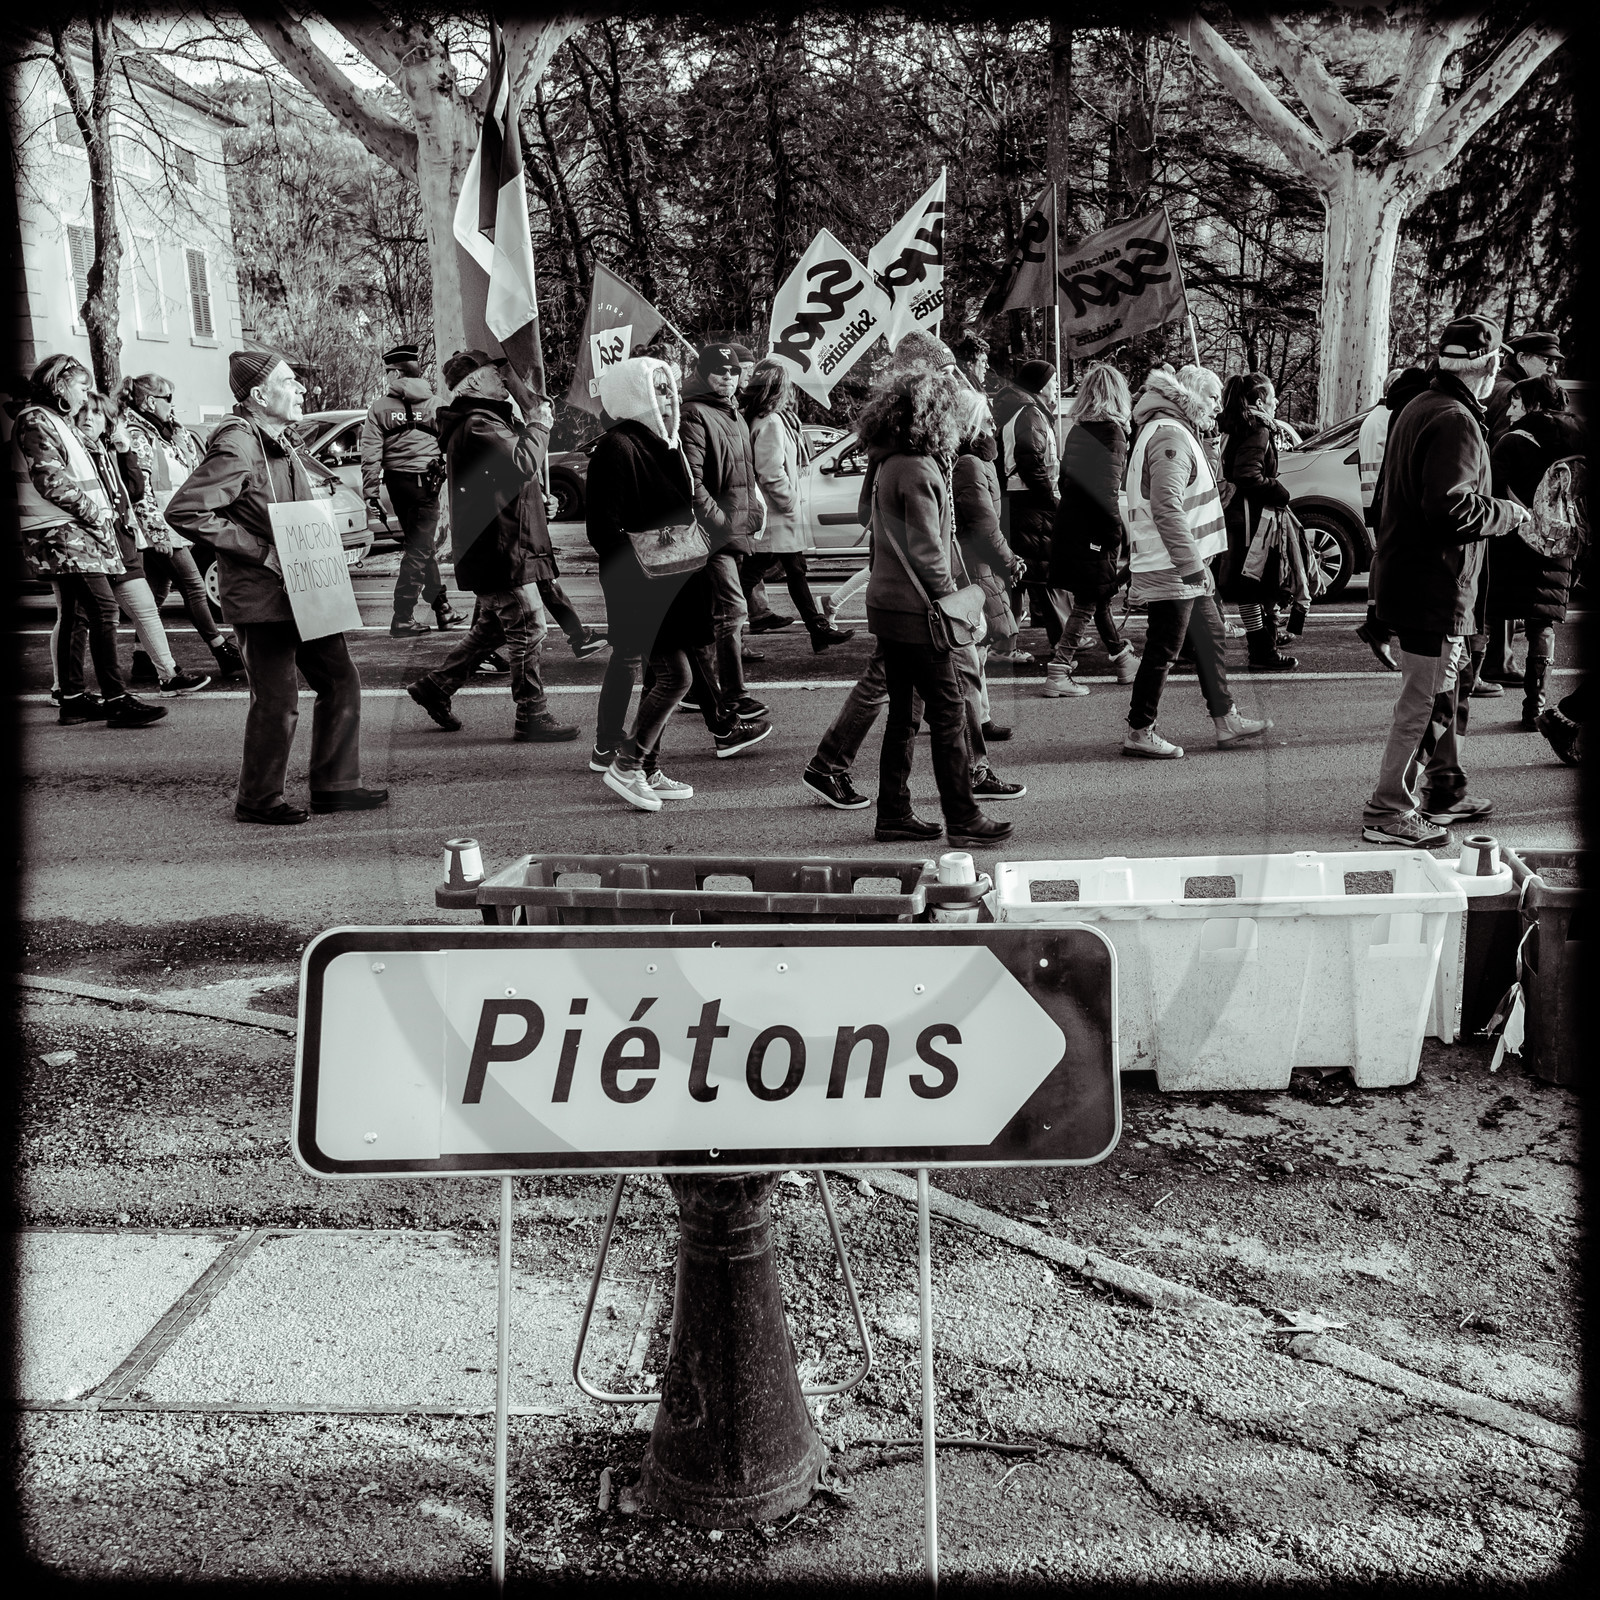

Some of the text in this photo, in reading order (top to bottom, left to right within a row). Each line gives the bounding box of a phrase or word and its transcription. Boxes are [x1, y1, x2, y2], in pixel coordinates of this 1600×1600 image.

[391, 412, 423, 421] POLE
[285, 522, 341, 553] MACRON
[462, 997, 964, 1104] Piétons
